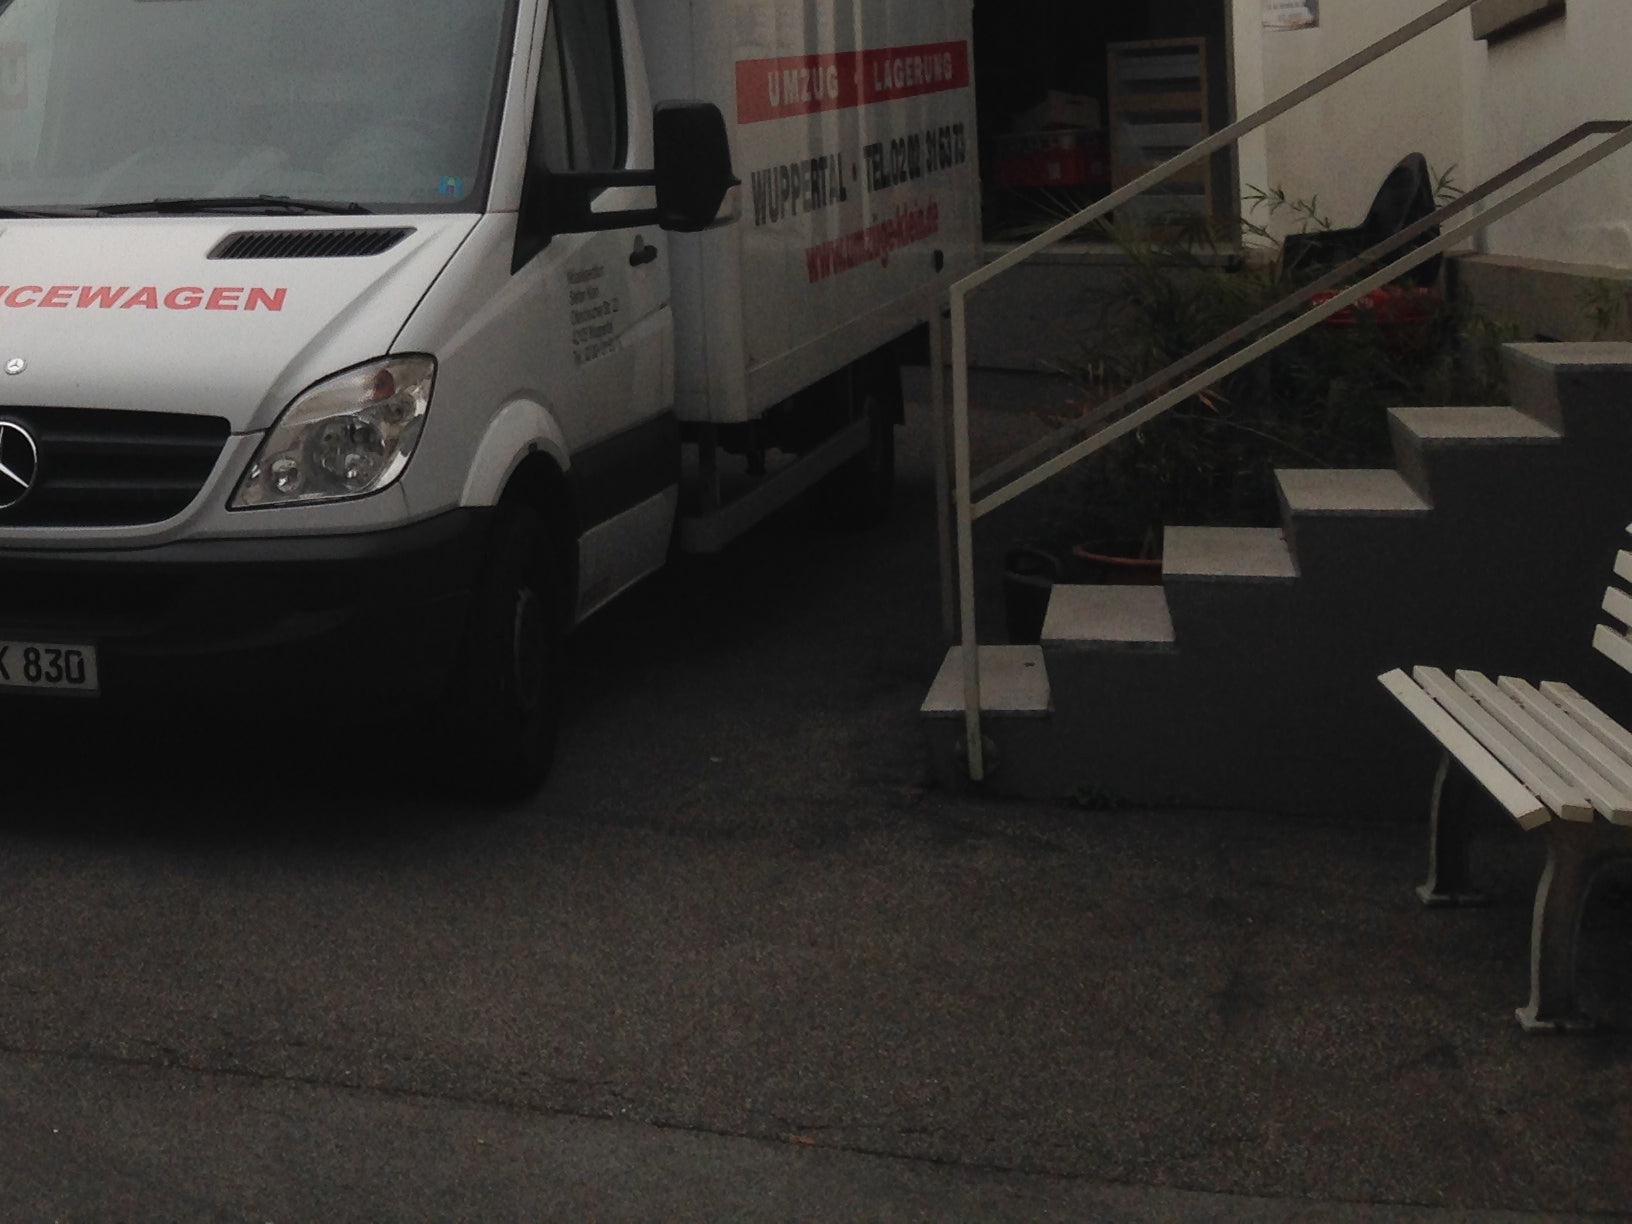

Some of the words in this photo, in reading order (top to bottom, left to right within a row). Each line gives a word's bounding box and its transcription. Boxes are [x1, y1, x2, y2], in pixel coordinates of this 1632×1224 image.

[768, 64, 839, 107] UMZUG
[873, 51, 953, 92] LAGERUNG
[751, 152, 846, 226] WUPPERTAL
[23, 647, 85, 684] 830
